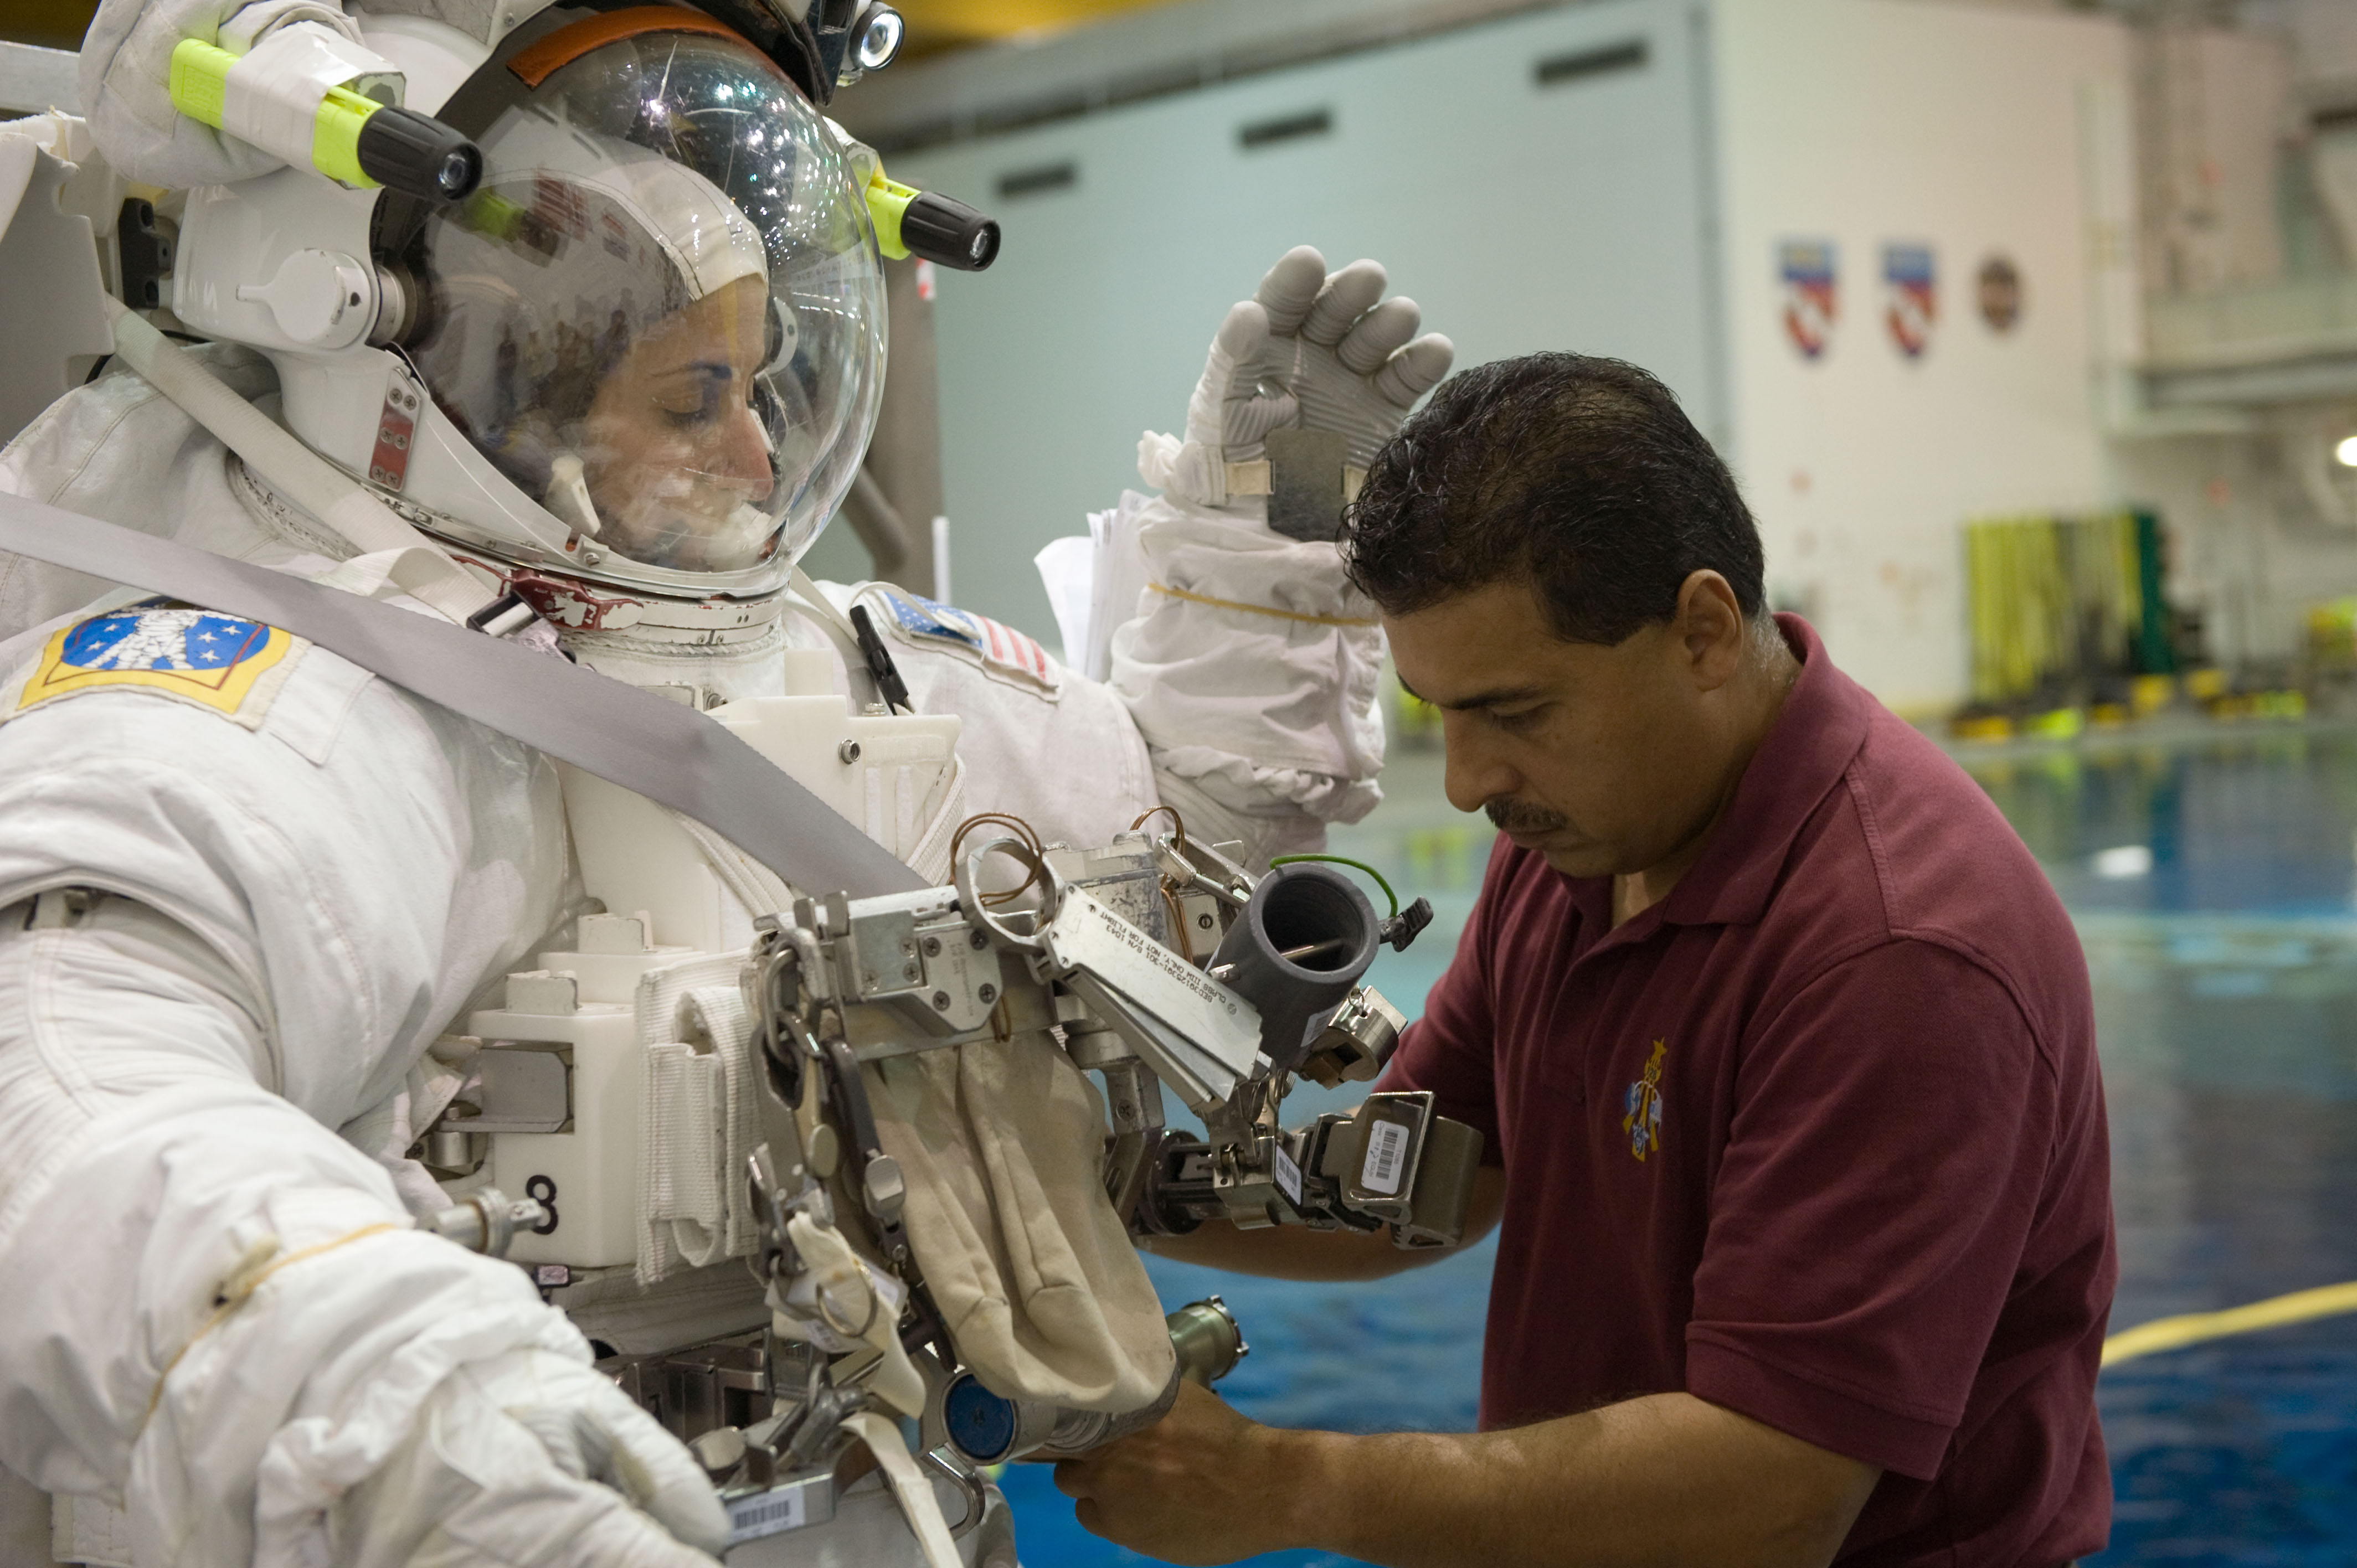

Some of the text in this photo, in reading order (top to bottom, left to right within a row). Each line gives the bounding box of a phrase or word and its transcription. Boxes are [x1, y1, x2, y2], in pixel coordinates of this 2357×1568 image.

[1099, 911, 1127, 933] FLIGHT
[1128, 931, 1144, 945] FOR
[1145, 943, 1161, 957] NOT
[526, 1174, 558, 1235] 8
